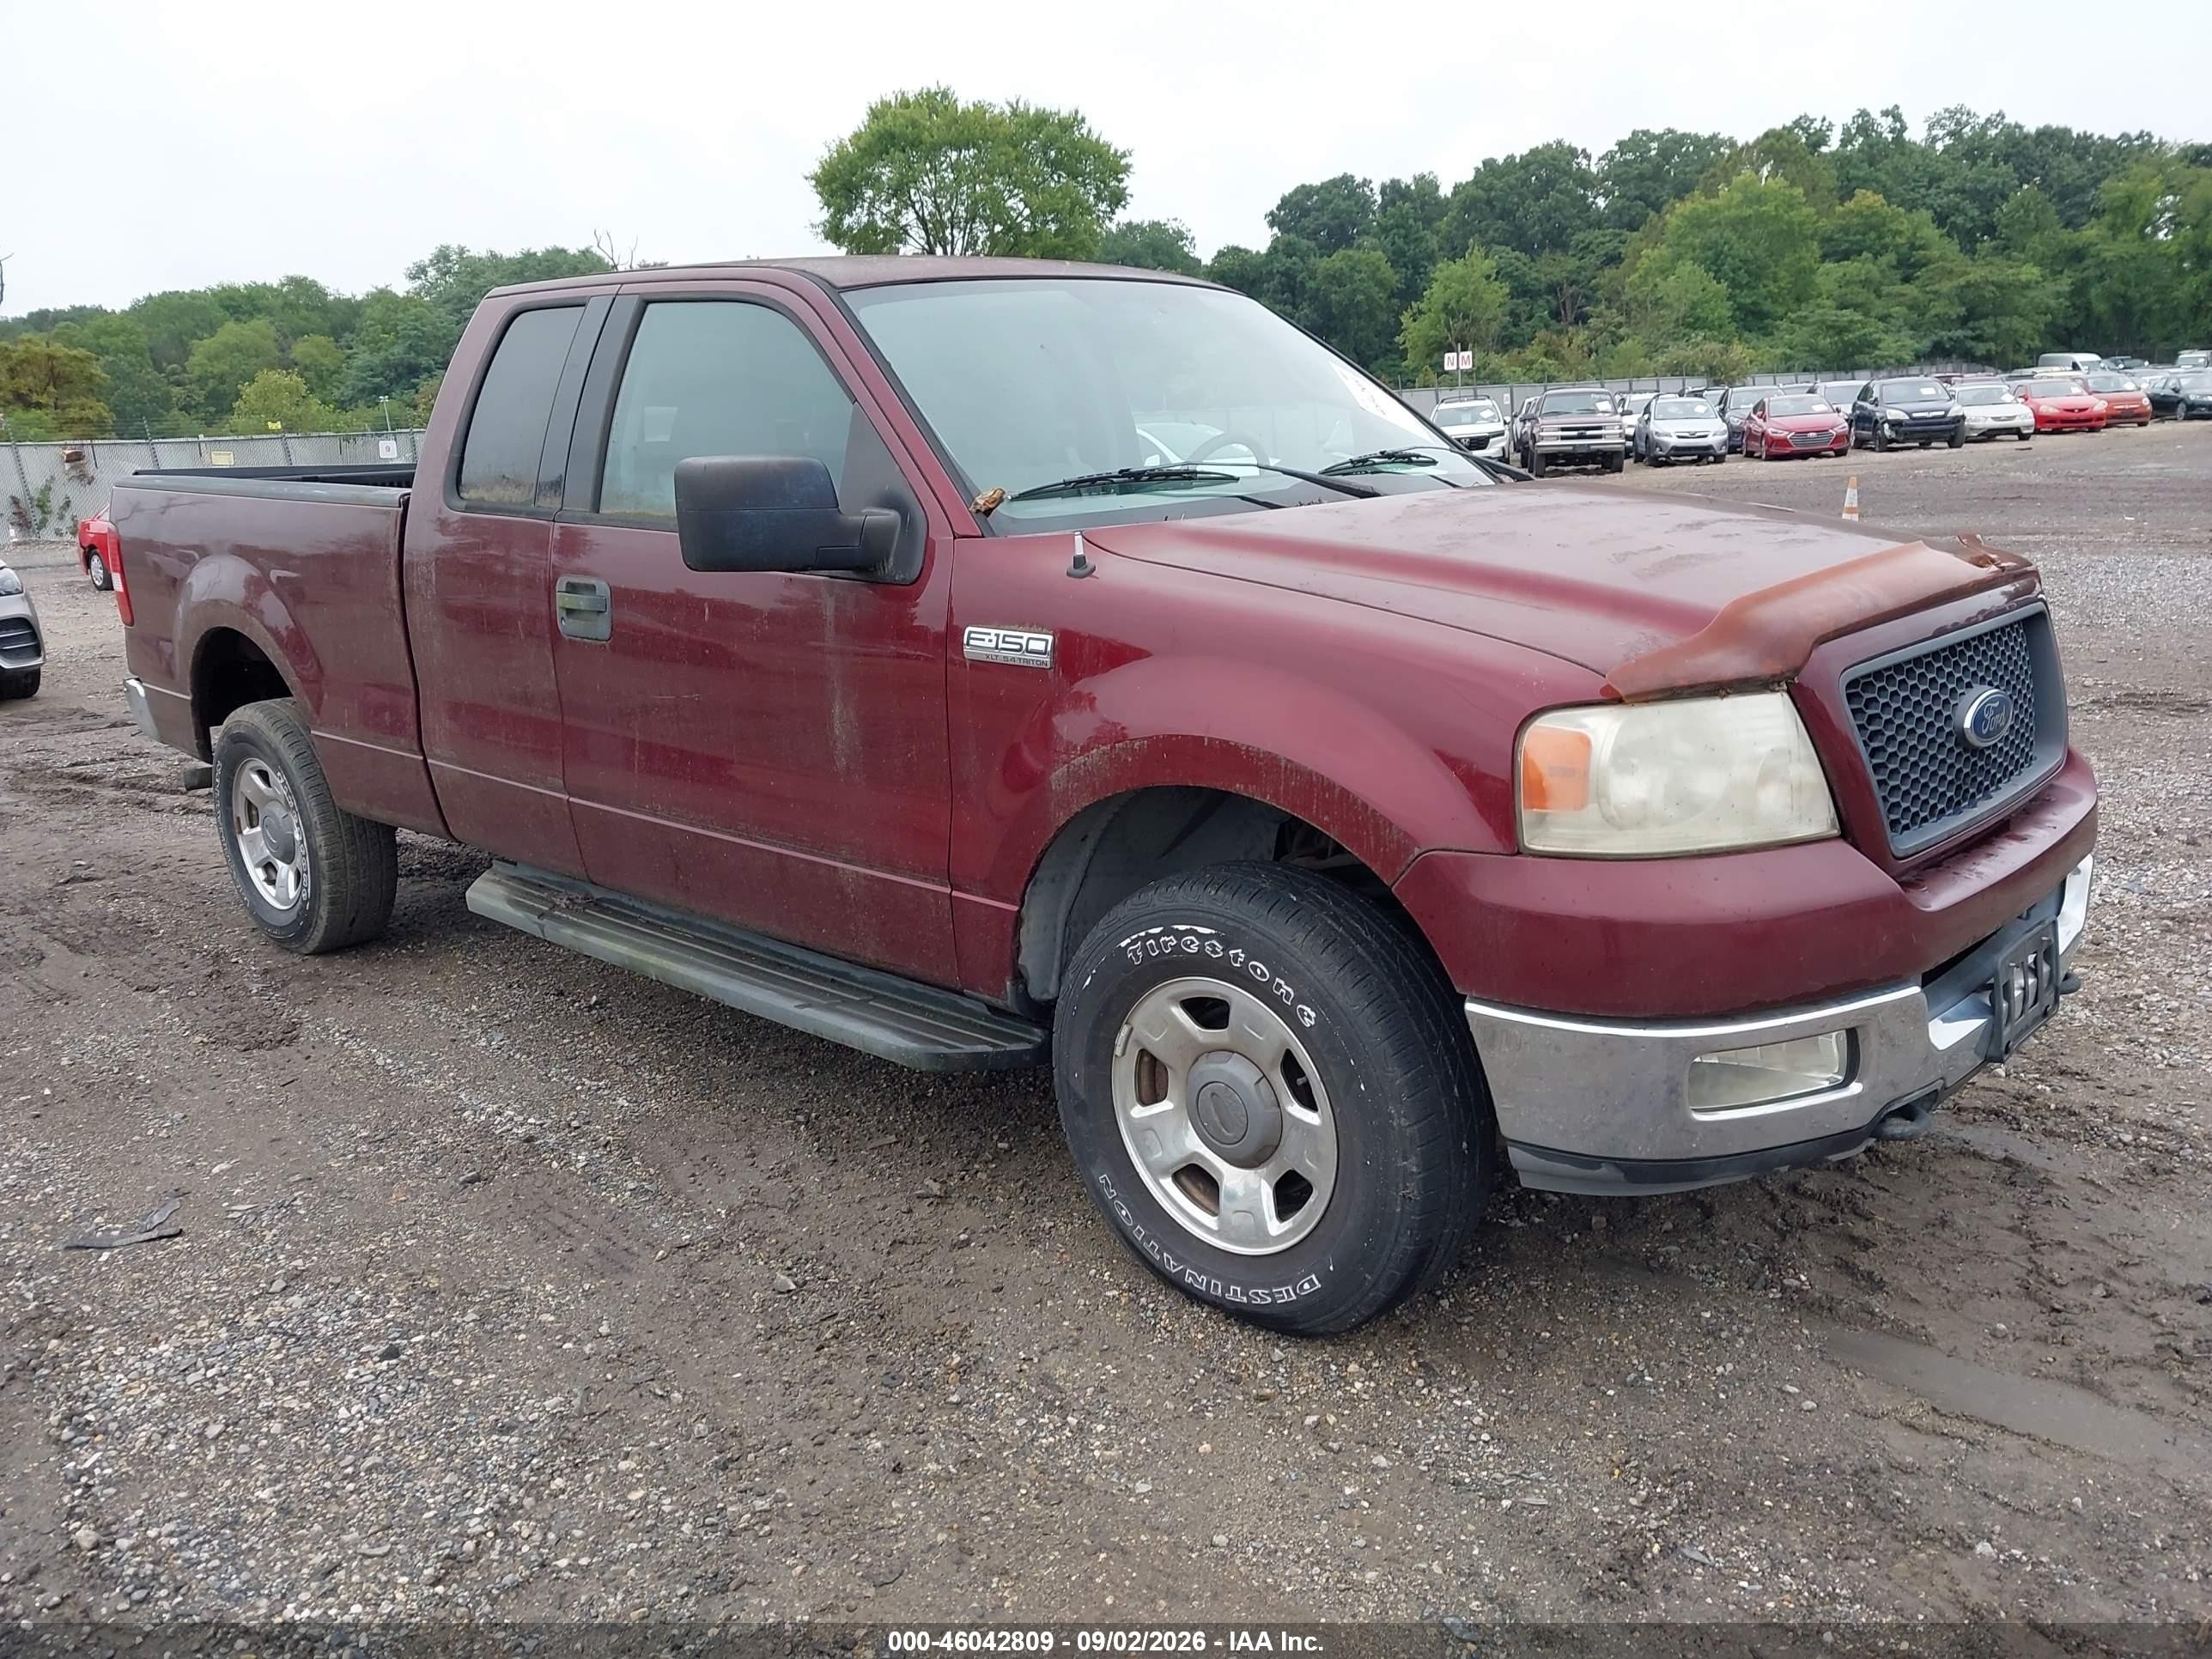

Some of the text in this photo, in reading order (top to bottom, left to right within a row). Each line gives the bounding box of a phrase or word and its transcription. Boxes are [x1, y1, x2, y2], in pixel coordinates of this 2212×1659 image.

[1447, 356, 1455, 368] N
[1461, 355, 1471, 367] M
[966, 630, 1049, 656] F-150
[1018, 658, 1048, 667] TRITON
[1982, 701, 2006, 735] Ford
[1127, 935, 1317, 1028] Firestone
[1098, 1174, 1322, 1304] DESTINATION
